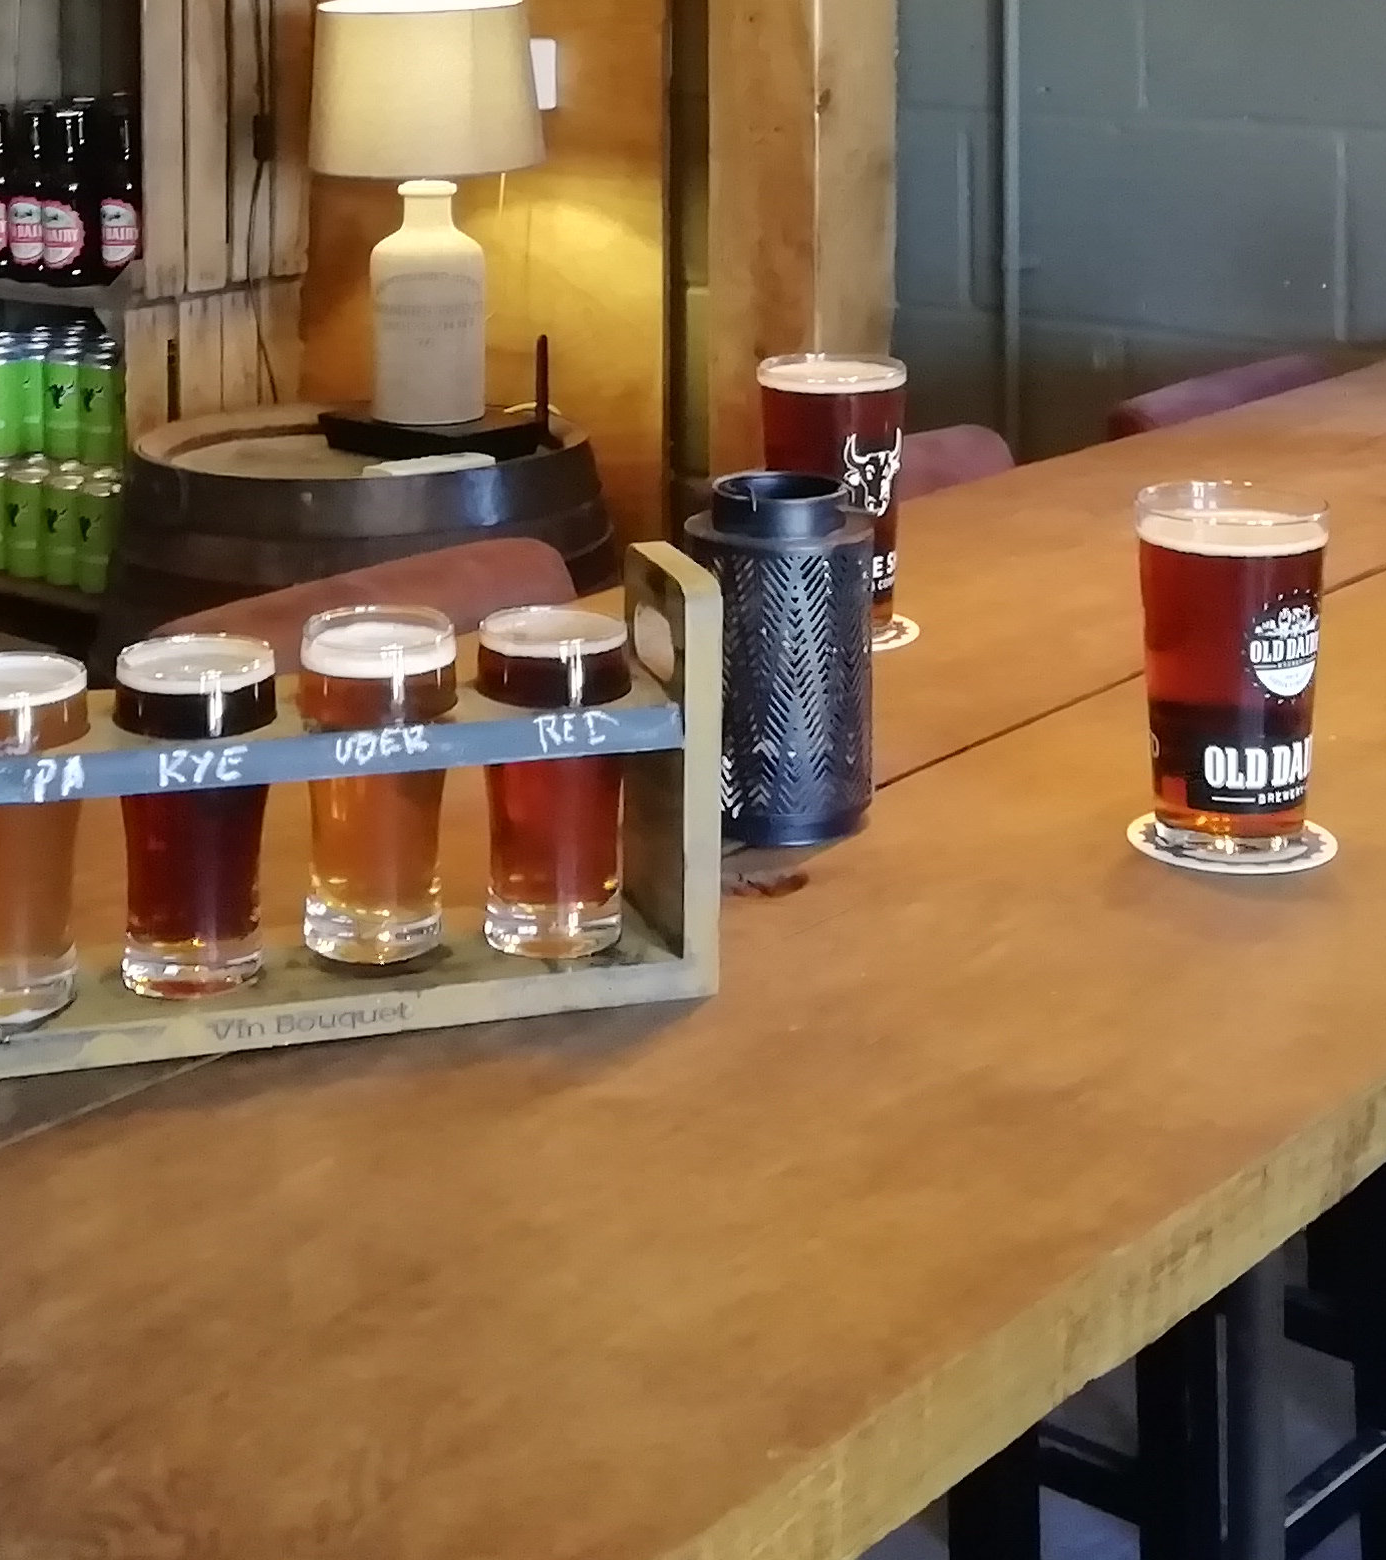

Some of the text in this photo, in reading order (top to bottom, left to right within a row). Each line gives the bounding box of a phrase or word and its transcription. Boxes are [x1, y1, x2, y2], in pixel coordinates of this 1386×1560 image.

[1249, 639, 1284, 664] OLD
[533, 710, 620, 754] RED
[1203, 734, 1314, 790] OLD DAI
[208, 1000, 410, 1042] Vin Bouquet
